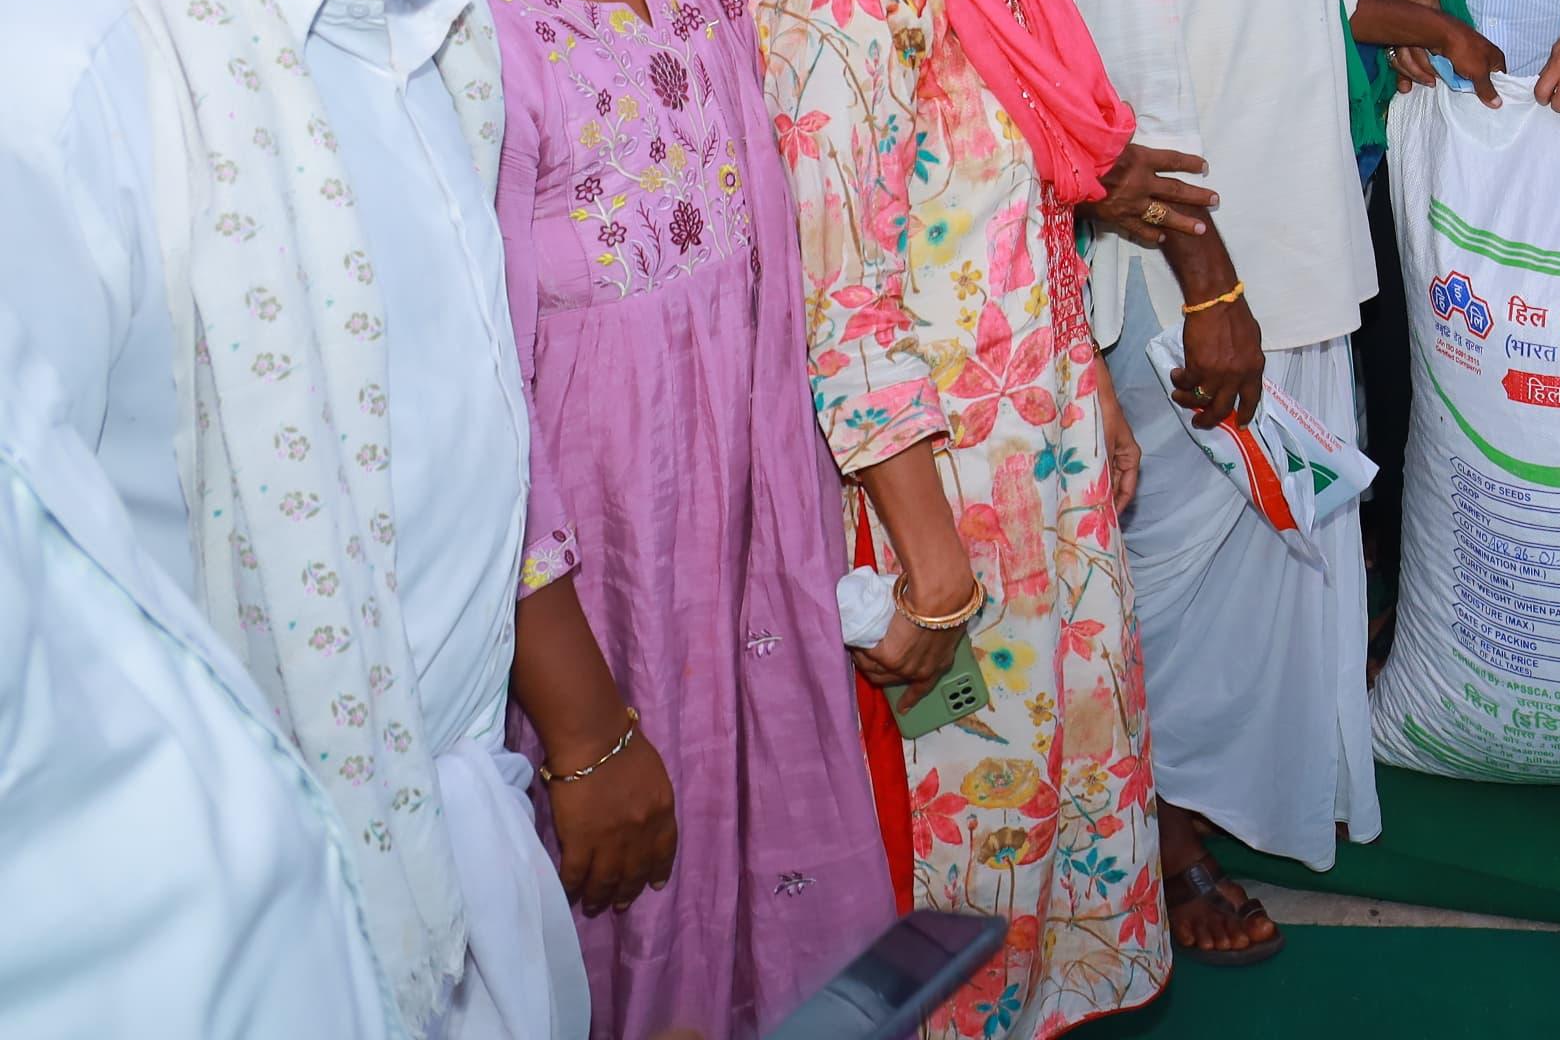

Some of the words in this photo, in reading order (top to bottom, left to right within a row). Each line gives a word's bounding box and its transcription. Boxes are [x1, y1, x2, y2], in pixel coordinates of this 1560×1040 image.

[1470, 305, 1484, 330] लि
[1507, 295, 1549, 328] हिल
[1505, 333, 1558, 362] (भारत
